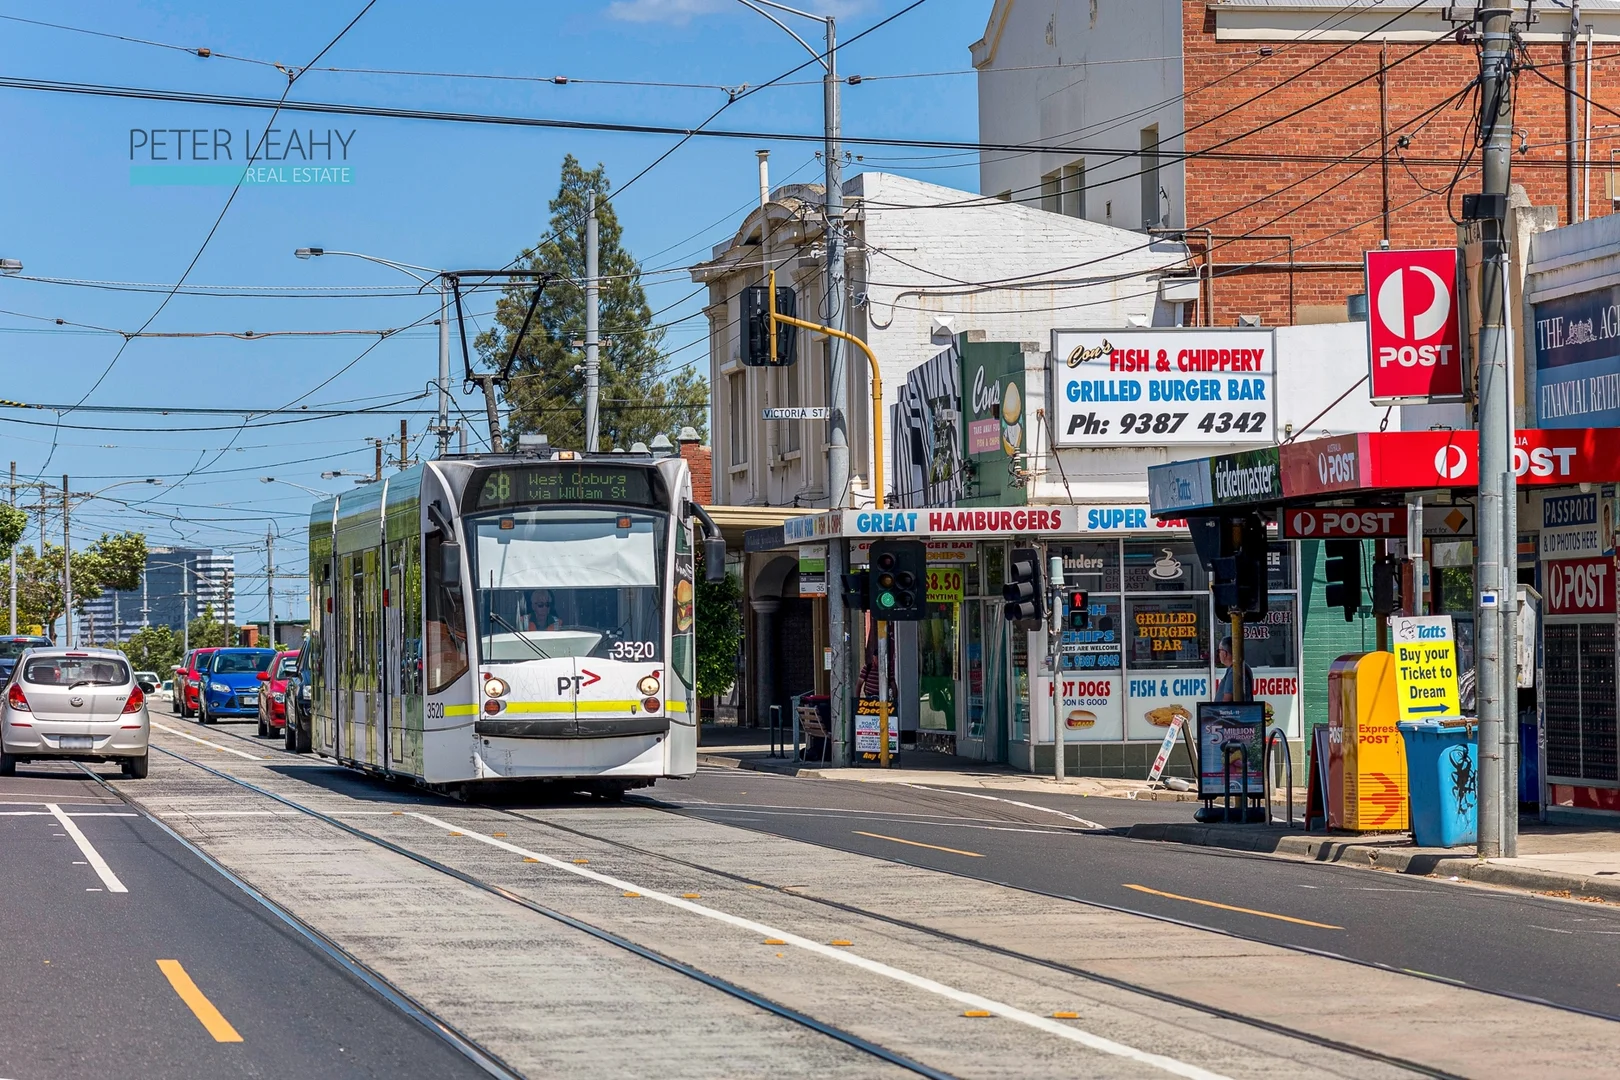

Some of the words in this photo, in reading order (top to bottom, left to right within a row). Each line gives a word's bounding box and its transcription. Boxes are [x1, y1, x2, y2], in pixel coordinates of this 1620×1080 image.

[1537, 316, 1564, 351] THE
[1067, 338, 1115, 369] Con's
[1109, 348, 1149, 372] FISH
[1155, 348, 1172, 372] &
[1177, 348, 1265, 372] CHIPPERY
[1379, 345, 1453, 368] POST
[1066, 380, 1142, 402] GRILLED
[1149, 379, 1222, 402] BURGER
[1227, 379, 1266, 401] BAR
[1541, 378, 1588, 419] FINANCIAL
[764, 408, 807, 418] VICTORIA
[812, 408, 824, 418] ST
[1067, 412, 1110, 435] Ph:
[1119, 412, 1189, 434] 9387
[1197, 411, 1267, 433] 4342
[1328, 452, 1355, 484] POST
[1514, 447, 1577, 477] OST
[485, 472, 511, 500] 58
[529, 473, 564, 486] West
[571, 472, 626, 485] Coburg
[1215, 459, 1273, 499] ticketmaster
[529, 487, 551, 500] via
[558, 486, 603, 499] William
[611, 486, 627, 499] St
[1175, 478, 1192, 500] Tatts
[1545, 497, 1595, 524] PASSPORT
[856, 512, 918, 533] GREAT
[929, 509, 1062, 532] HAMBURGERS
[1087, 508, 1148, 530] SUPER
[1322, 512, 1395, 534] POST
[1543, 535, 1549, 552] &
[1549, 534, 1556, 552] ID
[1557, 531, 1581, 552] PHOTOS
[1581, 530, 1598, 550] HERE
[1105, 568, 1148, 576] GRLLED
[1105, 575, 1150, 583] CHCKEN
[1105, 582, 1145, 590] BRAST
[1564, 563, 1607, 608] POST
[1136, 612, 1197, 625] GRILLED
[1139, 625, 1197, 638] BURGER
[1416, 625, 1447, 639] Tatts
[613, 641, 655, 659] 3520
[1090, 644, 1119, 652] WELCOME
[1153, 639, 1183, 651] BAR
[1074, 655, 1096, 668] 9387
[1097, 654, 1120, 667] 4342
[1400, 647, 1421, 664] Buy
[1424, 648, 1449, 664] your
[1400, 665, 1437, 680] Ticket
[1440, 665, 1452, 679] to
[1078, 681, 1111, 697] DOGS
[1130, 680, 1157, 698] FISH
[1160, 680, 1169, 697] &
[1172, 678, 1207, 696] CHIPS
[1409, 685, 1446, 700] Dream
[427, 702, 444, 719] 3520
[1086, 698, 1108, 706] GOOD
[1223, 727, 1256, 735] MILLION
[1329, 726, 1344, 744] POST
[1358, 723, 1400, 734] Express
[1358, 735, 1390, 745] POST
